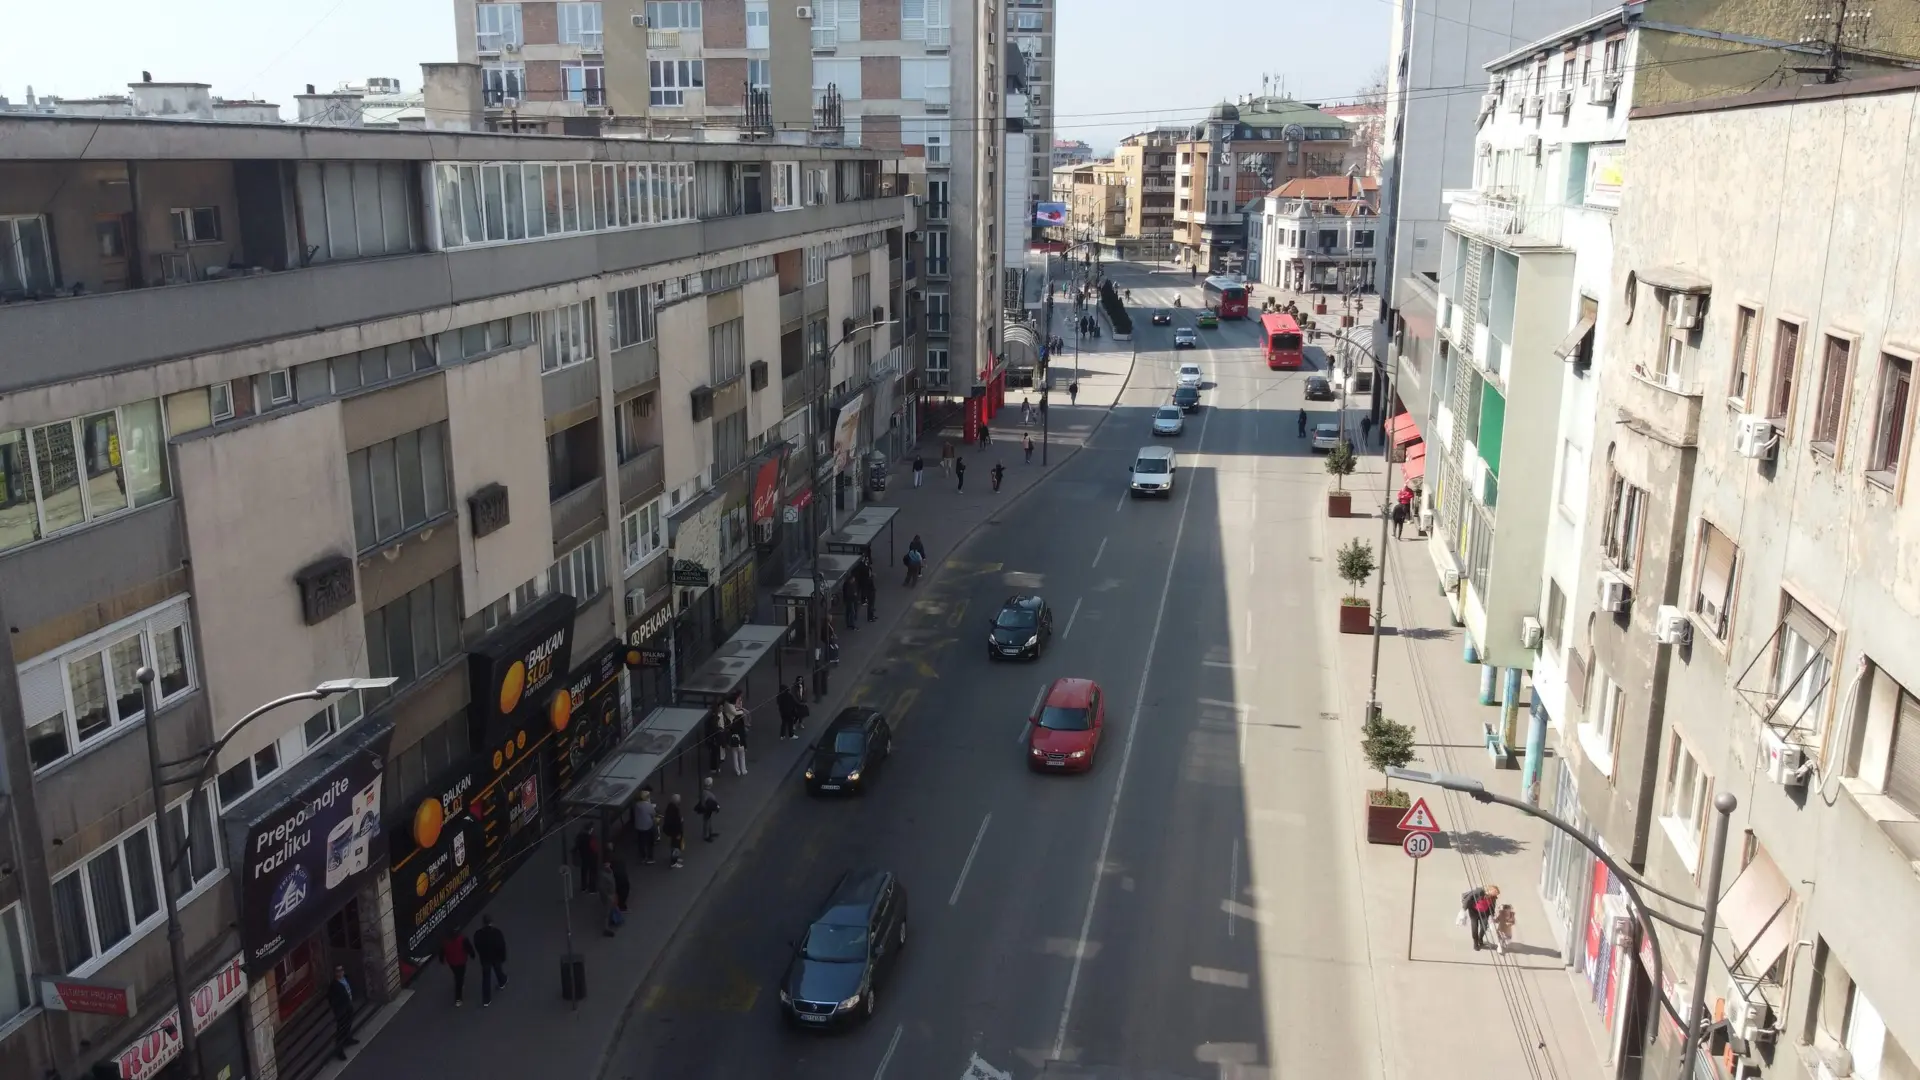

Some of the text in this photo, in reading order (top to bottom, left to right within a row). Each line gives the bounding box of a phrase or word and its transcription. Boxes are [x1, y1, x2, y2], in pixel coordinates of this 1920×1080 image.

[640, 603, 673, 643] PEKARA
[528, 628, 565, 669] BALKAN
[526, 655, 553, 688] SLOT
[571, 672, 592, 698] BALKAN
[443, 773, 472, 807] BALKAN
[256, 776, 350, 853] Preponajte
[254, 829, 311, 880] razliku
[1410, 838, 1427, 852] 30
[274, 882, 307, 922] ZEN
[255, 934, 281, 959] Softness
